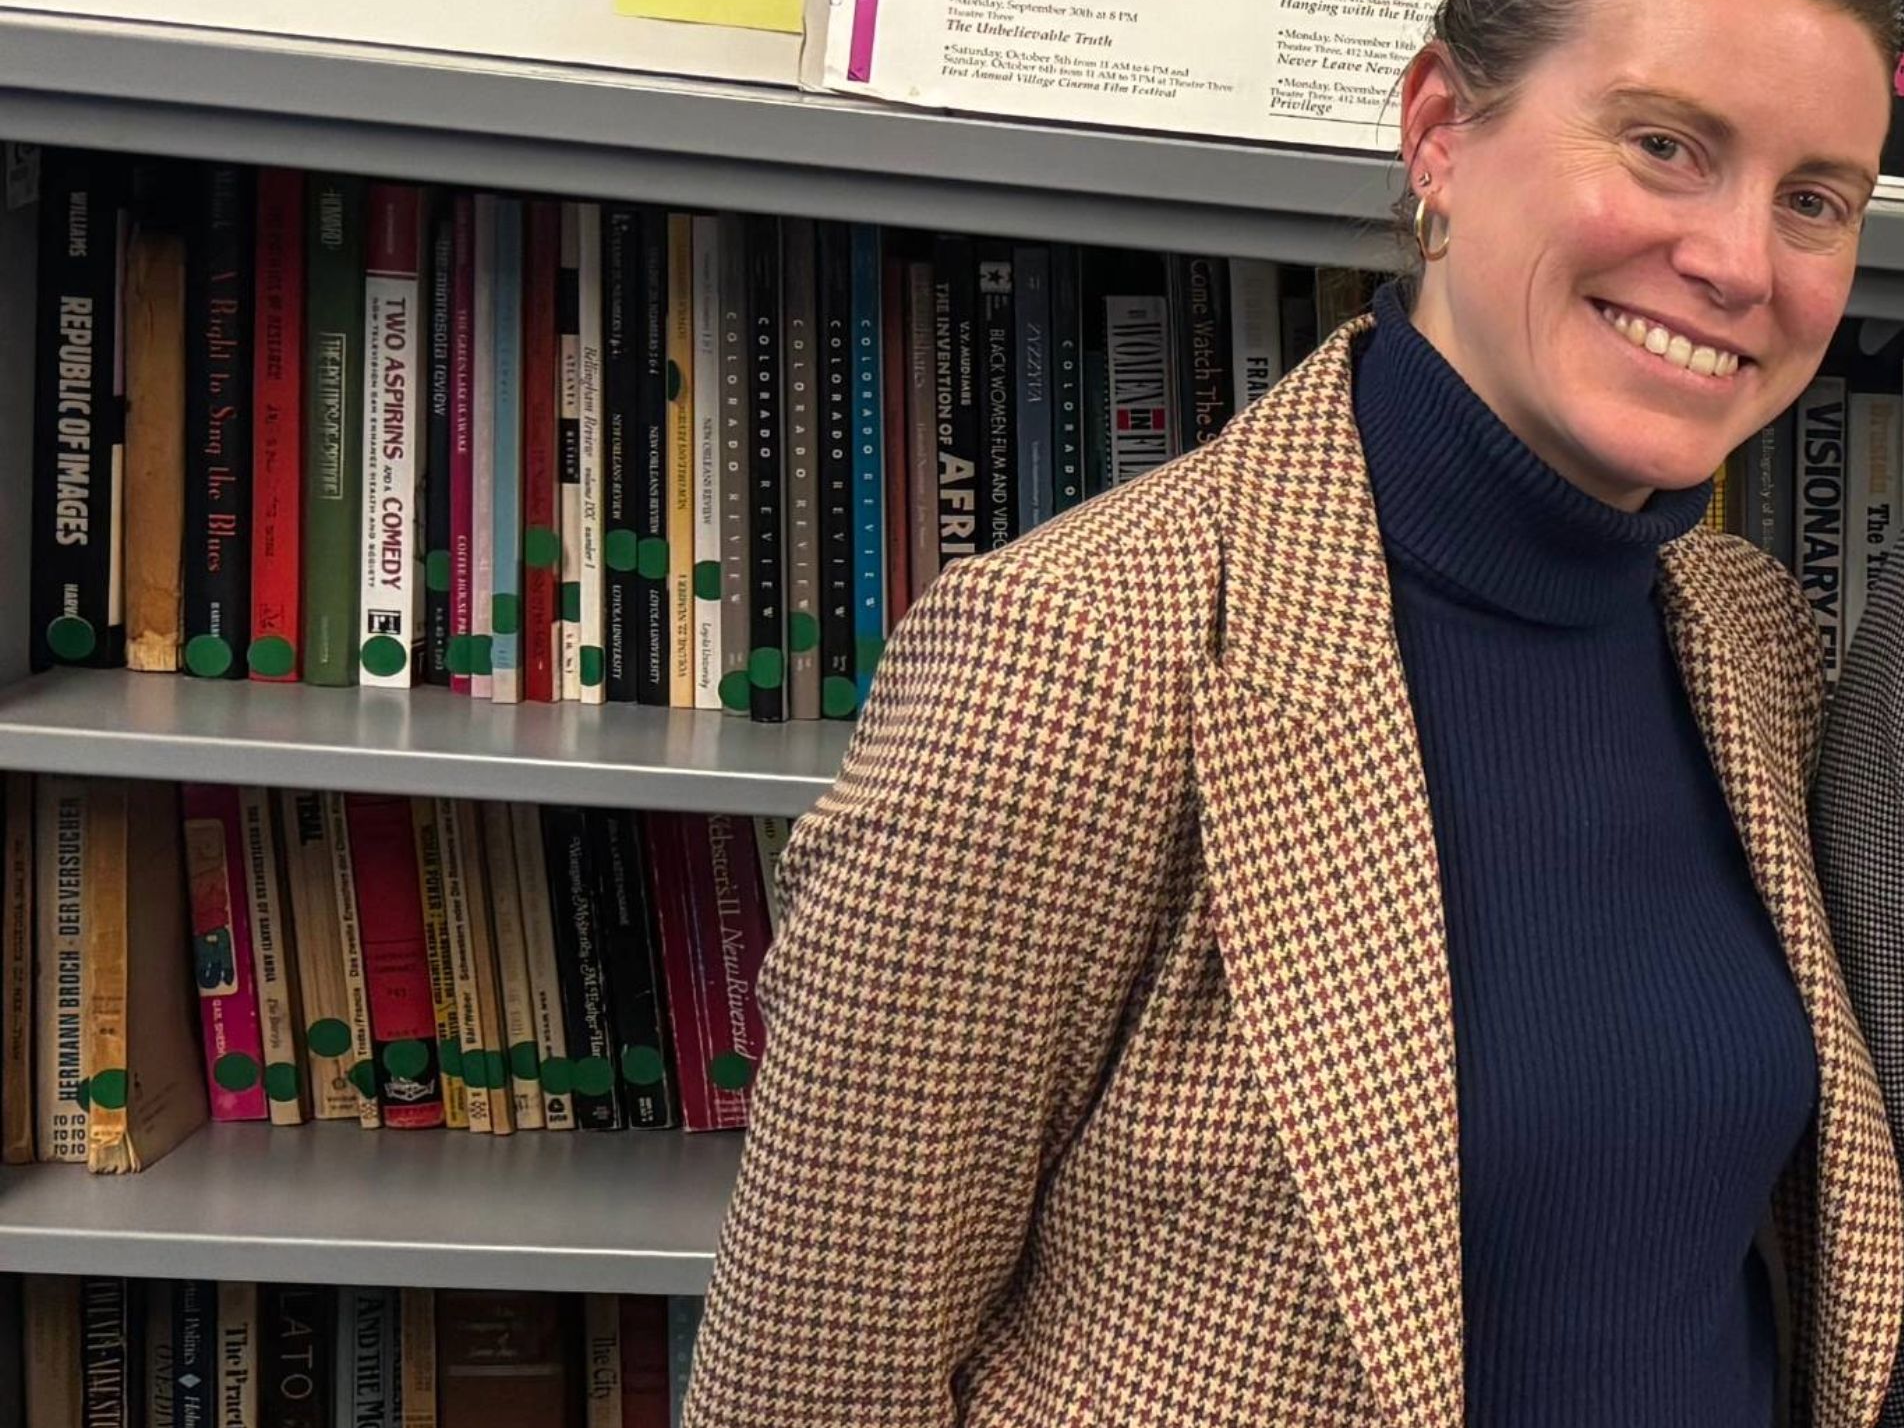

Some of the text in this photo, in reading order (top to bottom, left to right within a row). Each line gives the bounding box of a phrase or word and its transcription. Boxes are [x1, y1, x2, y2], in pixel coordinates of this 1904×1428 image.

[385, 297, 406, 351] TWO
[936, 283, 953, 446] THE INVENTION OF
[56, 296, 92, 546] REPUBLIC OF IMAGES
[382, 356, 405, 461] ASPIRINS
[383, 465, 392, 484] AND
[1803, 402, 1843, 624] VISIONARY
[381, 497, 403, 590] COMEDY
[58, 797, 81, 936] DER VERSUCHER
[58, 951, 80, 1101] HERMANN BROCH
[225, 1323, 248, 1371] The
